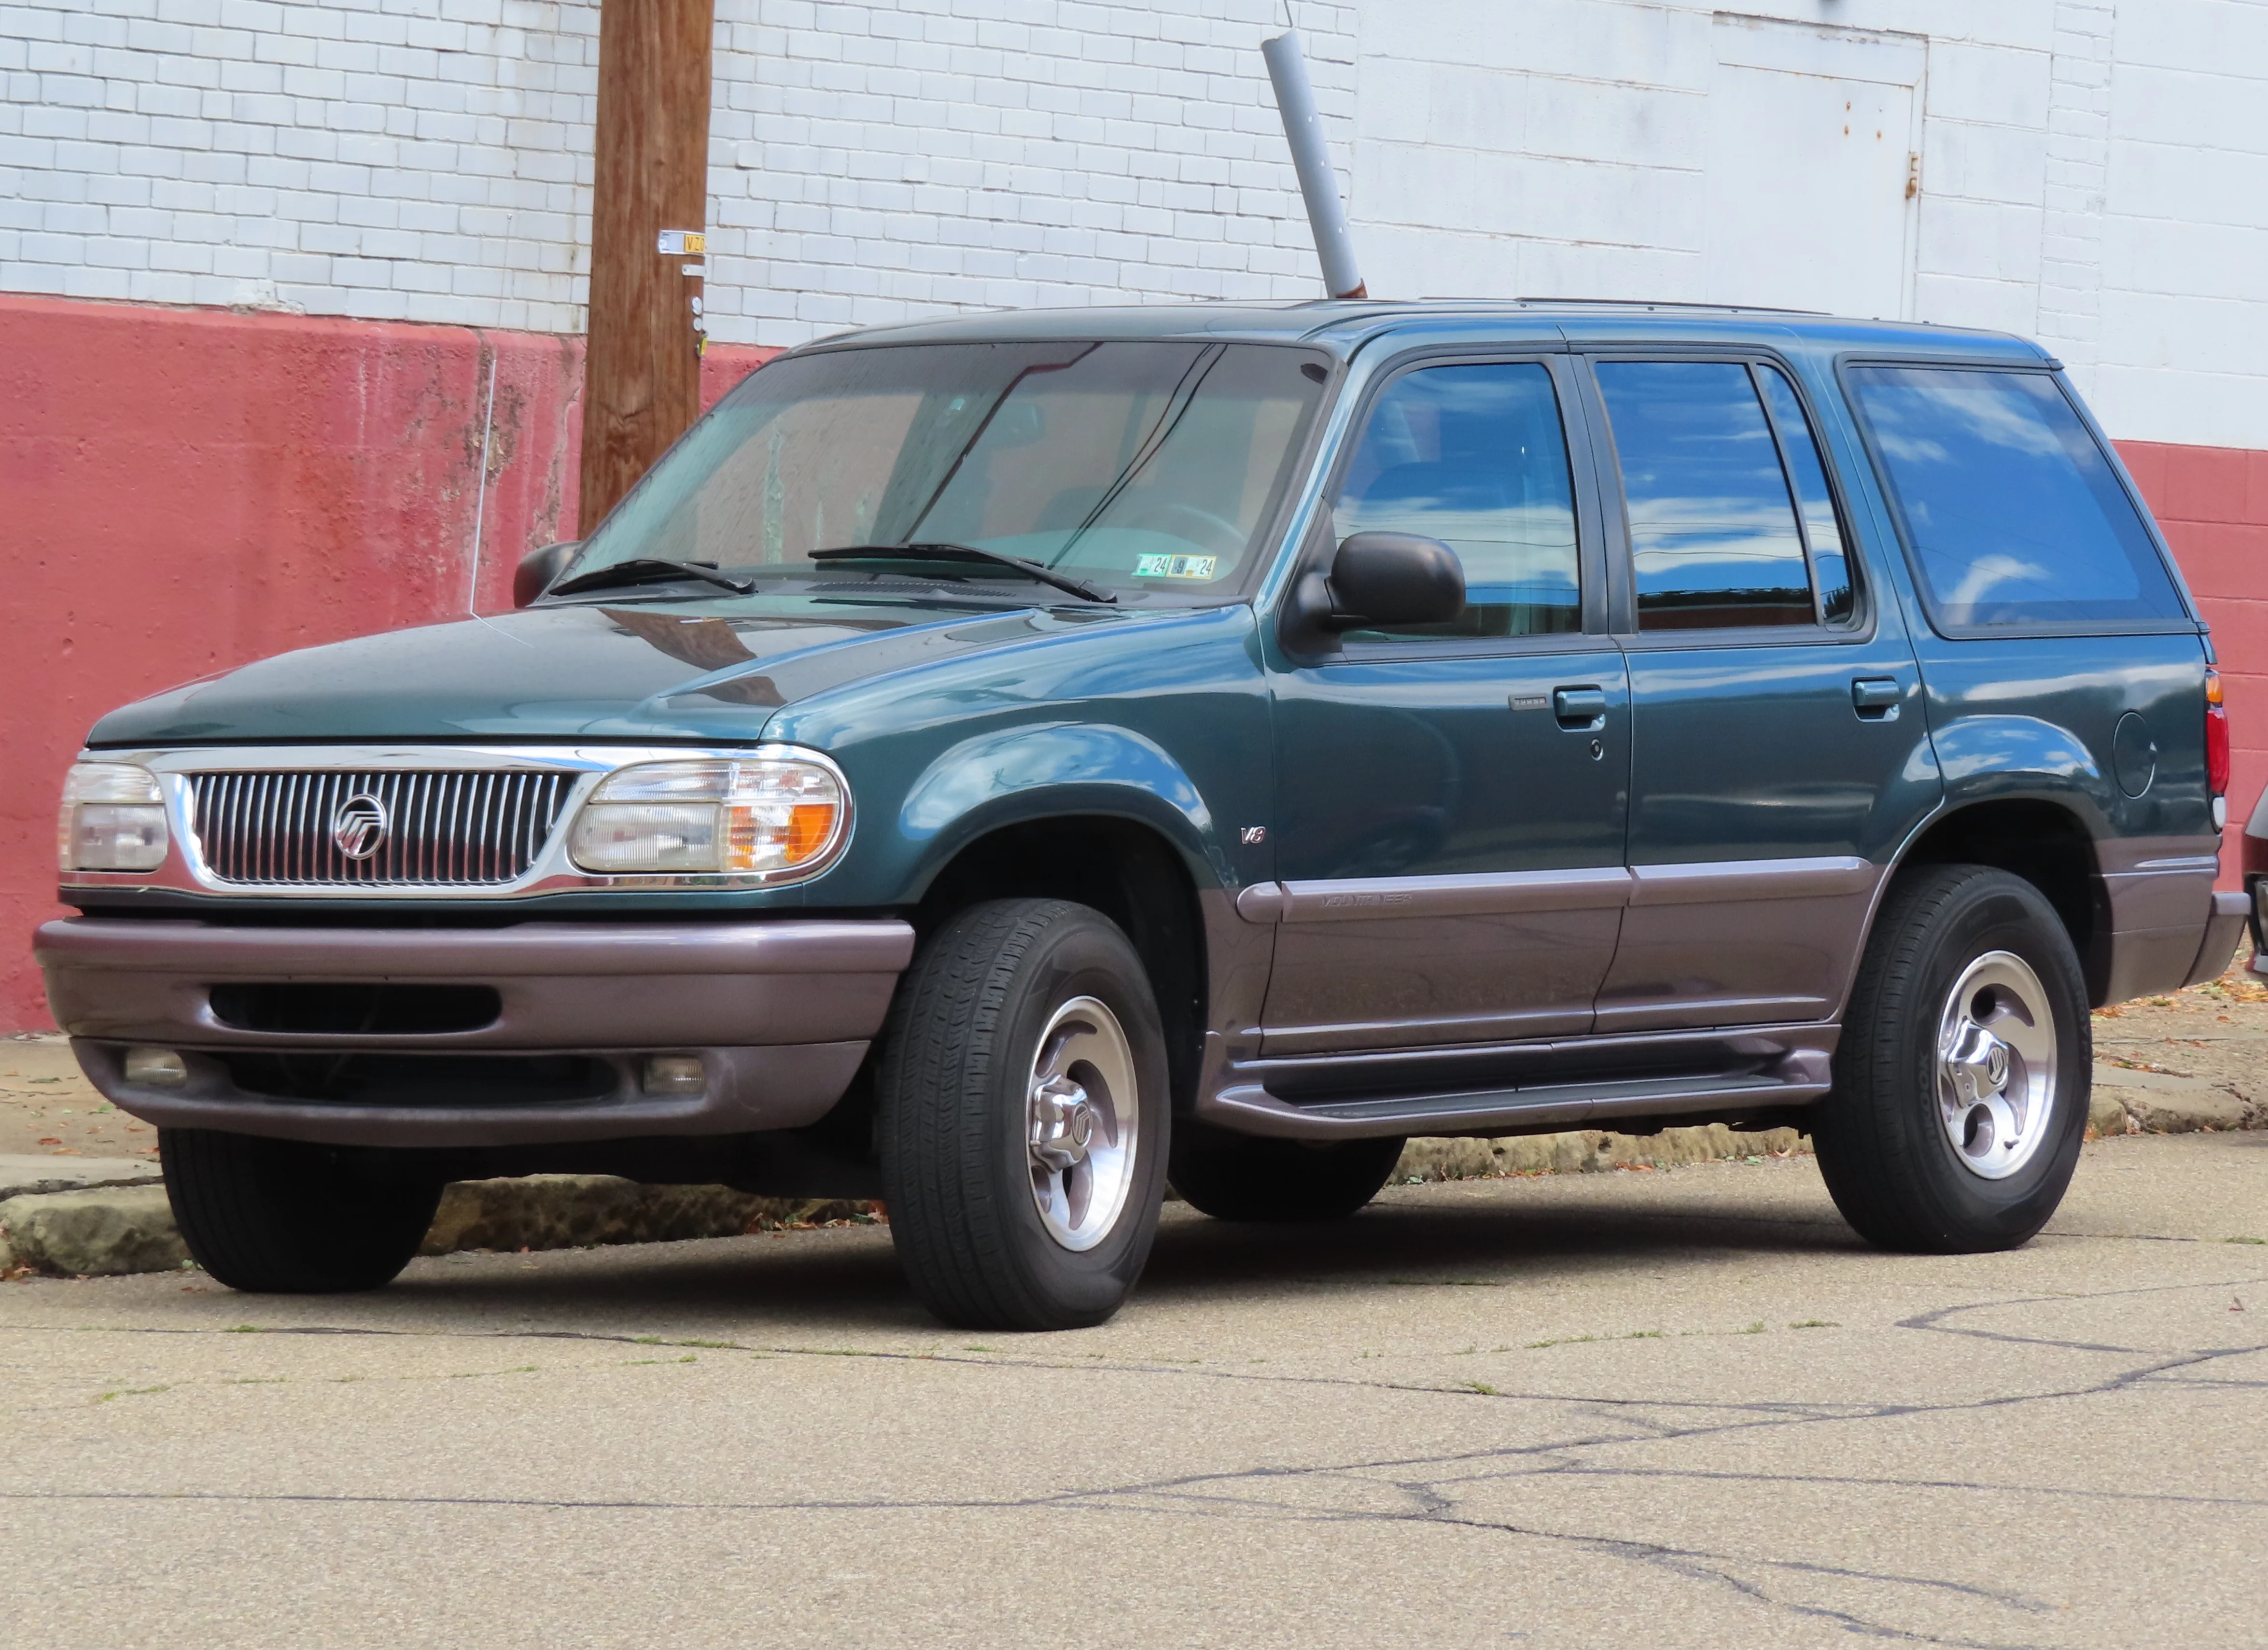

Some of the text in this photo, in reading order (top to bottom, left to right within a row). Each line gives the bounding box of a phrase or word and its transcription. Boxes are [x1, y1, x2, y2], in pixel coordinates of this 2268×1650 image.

[1154, 557, 1167, 573] 24
[1200, 559, 1213, 575] 24
[1240, 825, 1266, 844] V8
